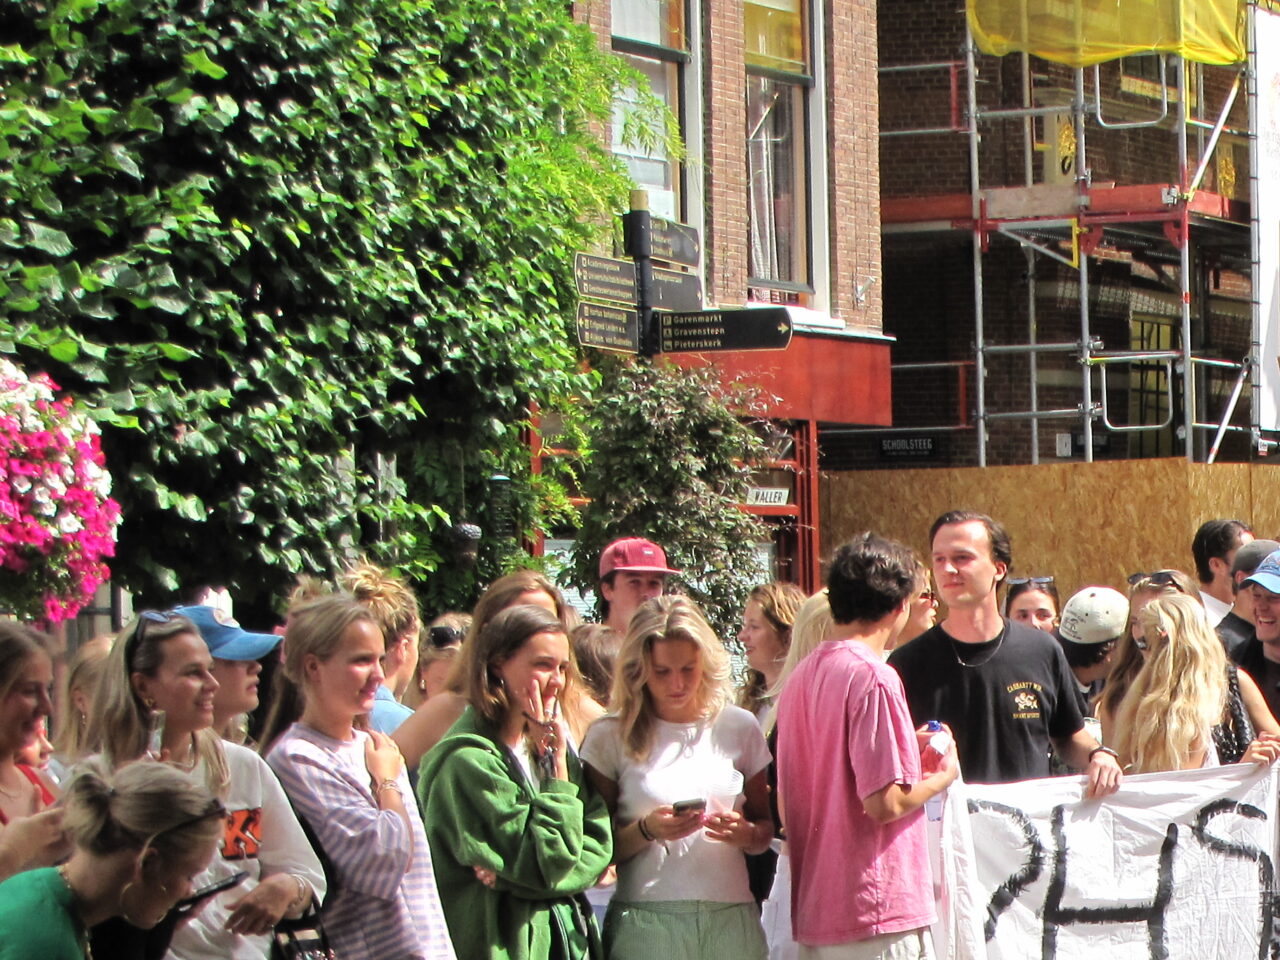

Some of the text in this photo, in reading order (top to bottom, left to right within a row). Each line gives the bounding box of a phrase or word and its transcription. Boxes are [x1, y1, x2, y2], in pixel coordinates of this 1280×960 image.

[673, 314, 722, 324] Garenmarkt
[674, 327, 725, 336] Gravensteen
[674, 339, 722, 348] Pieterskerk
[882, 438, 933, 450] SCHOOLSTEEG
[754, 491, 783, 504] WALLER
